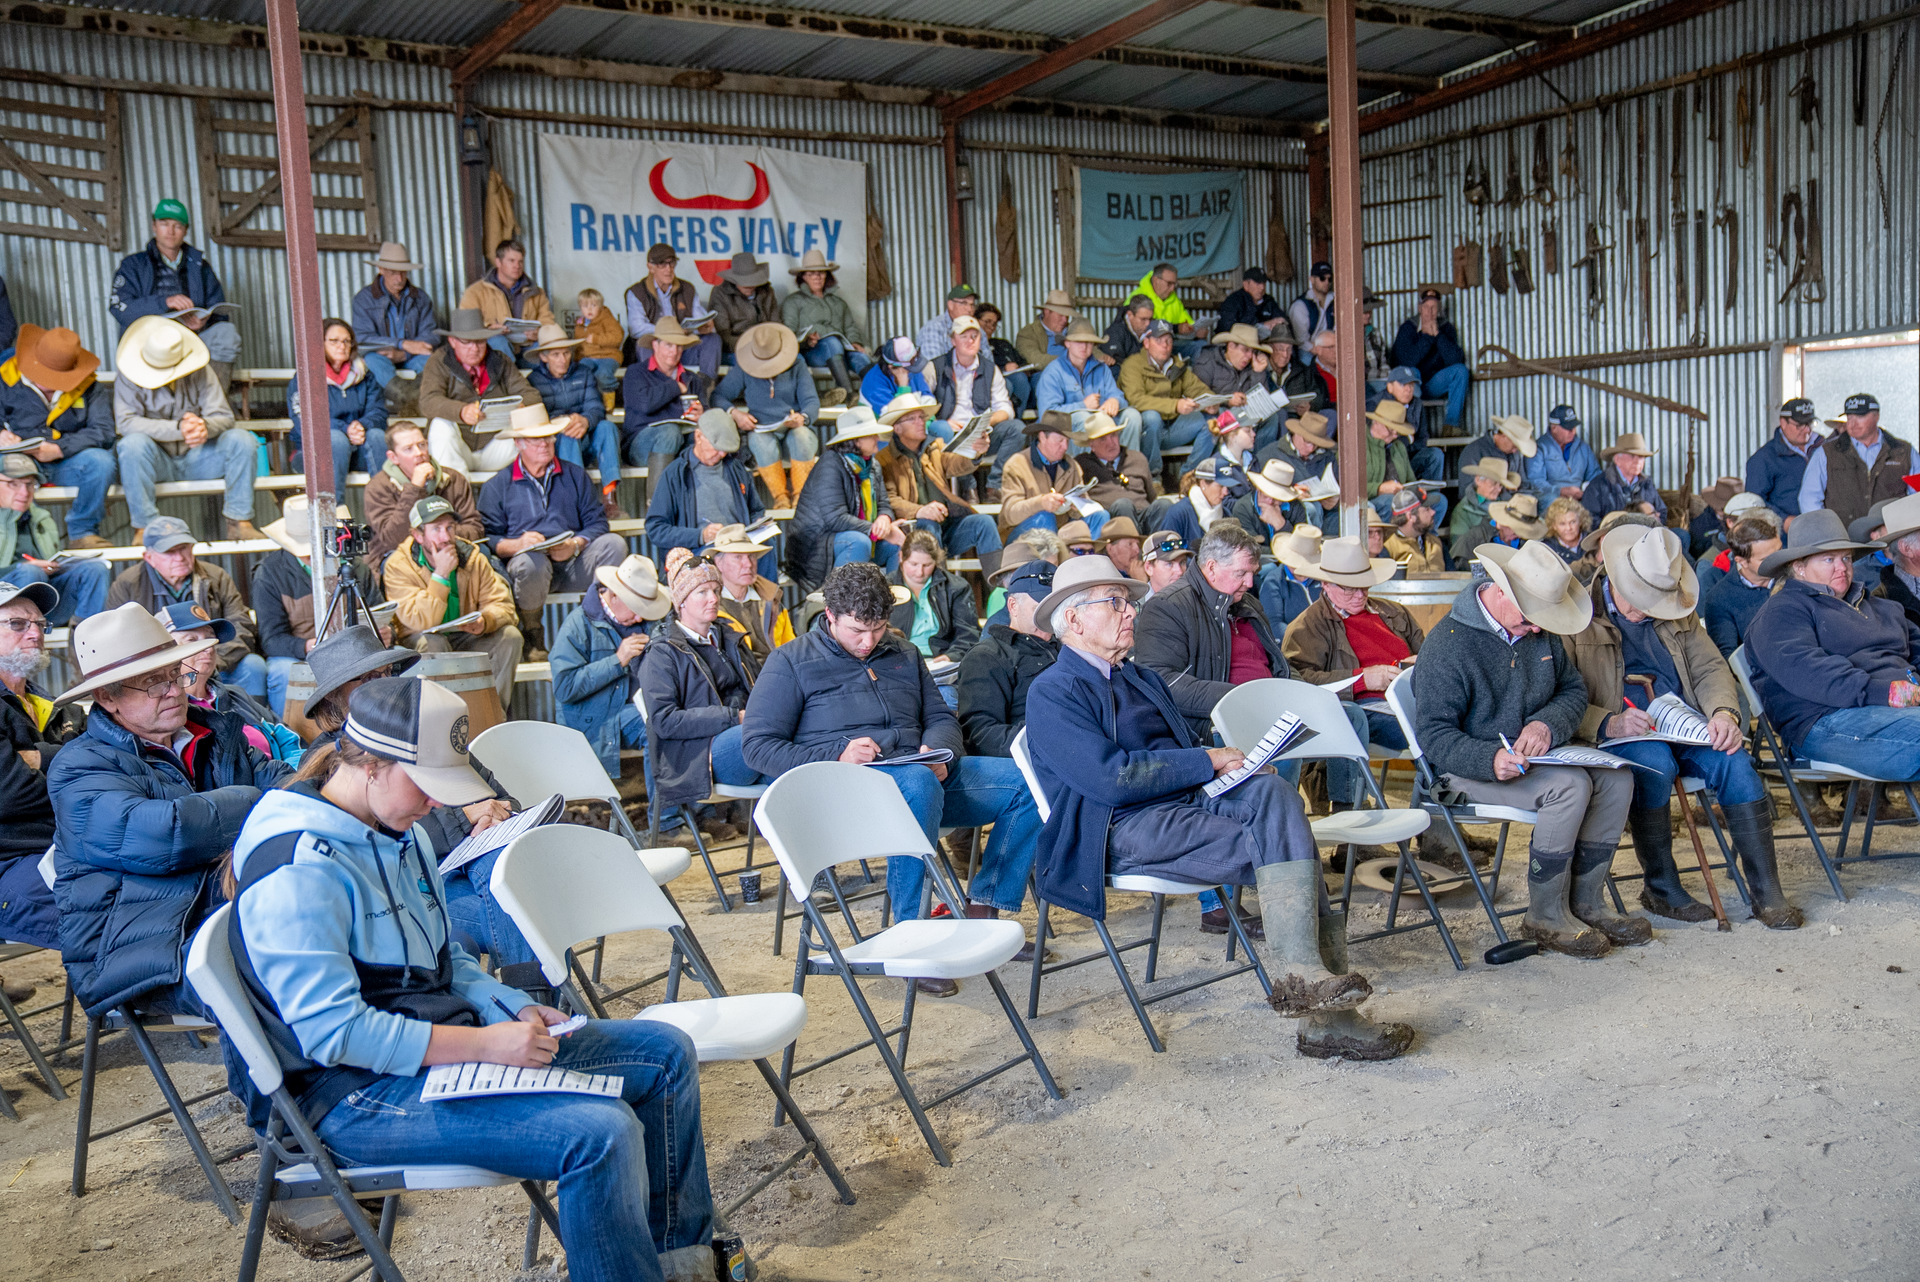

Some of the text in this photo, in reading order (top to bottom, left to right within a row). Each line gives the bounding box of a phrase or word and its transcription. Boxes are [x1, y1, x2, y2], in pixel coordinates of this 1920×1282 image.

[1107, 189, 1231, 221] BALD BLAIR
[570, 202, 842, 261] RANGERS VALLEY
[1135, 231, 1207, 261] ANGUS
